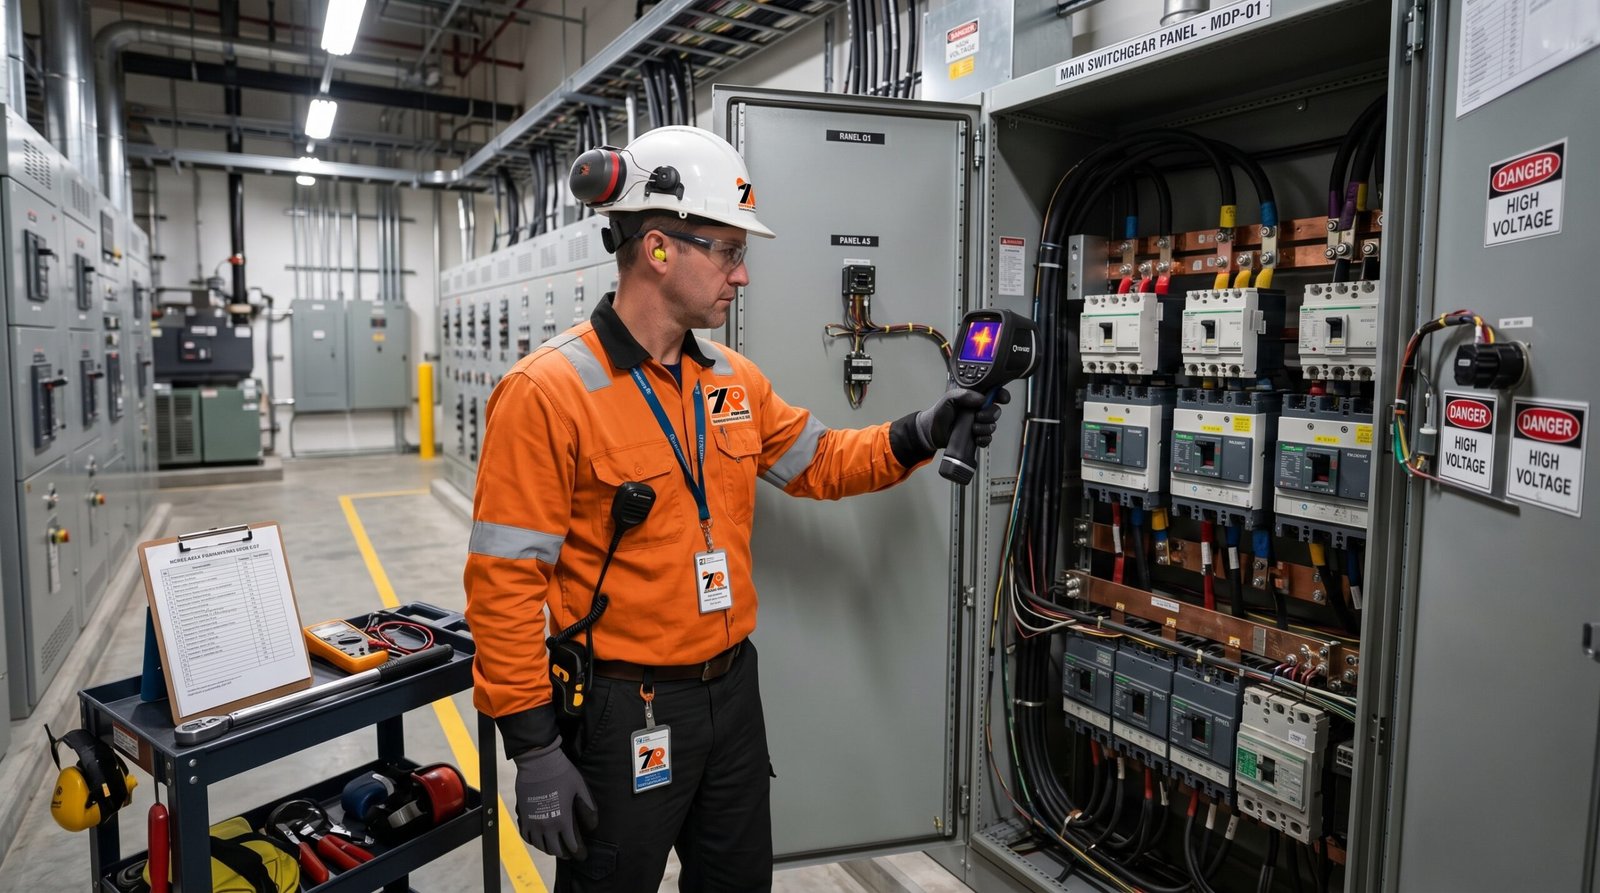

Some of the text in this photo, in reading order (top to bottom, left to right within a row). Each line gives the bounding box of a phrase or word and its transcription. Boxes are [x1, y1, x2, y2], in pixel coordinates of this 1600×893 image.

[1060, 62, 1085, 81] MAIN
[1088, 38, 1156, 71] SWITCHGEAR
[1160, 24, 1197, 48] PANEL
[1210, 1, 1261, 31] MDP-01
[1498, 156, 1552, 188] DANGER
[1507, 191, 1539, 215] HIGH
[1493, 208, 1553, 237] VOLTAGE
[839, 236, 861, 245] PANEL
[1449, 405, 1486, 424] DANGER
[1522, 414, 1573, 437] DANGER
[1454, 435, 1477, 453] HIGH
[1445, 452, 1486, 475] VOLTAGE
[1529, 449, 1560, 471] HIGH
[1516, 467, 1572, 496] VOLTAGE
